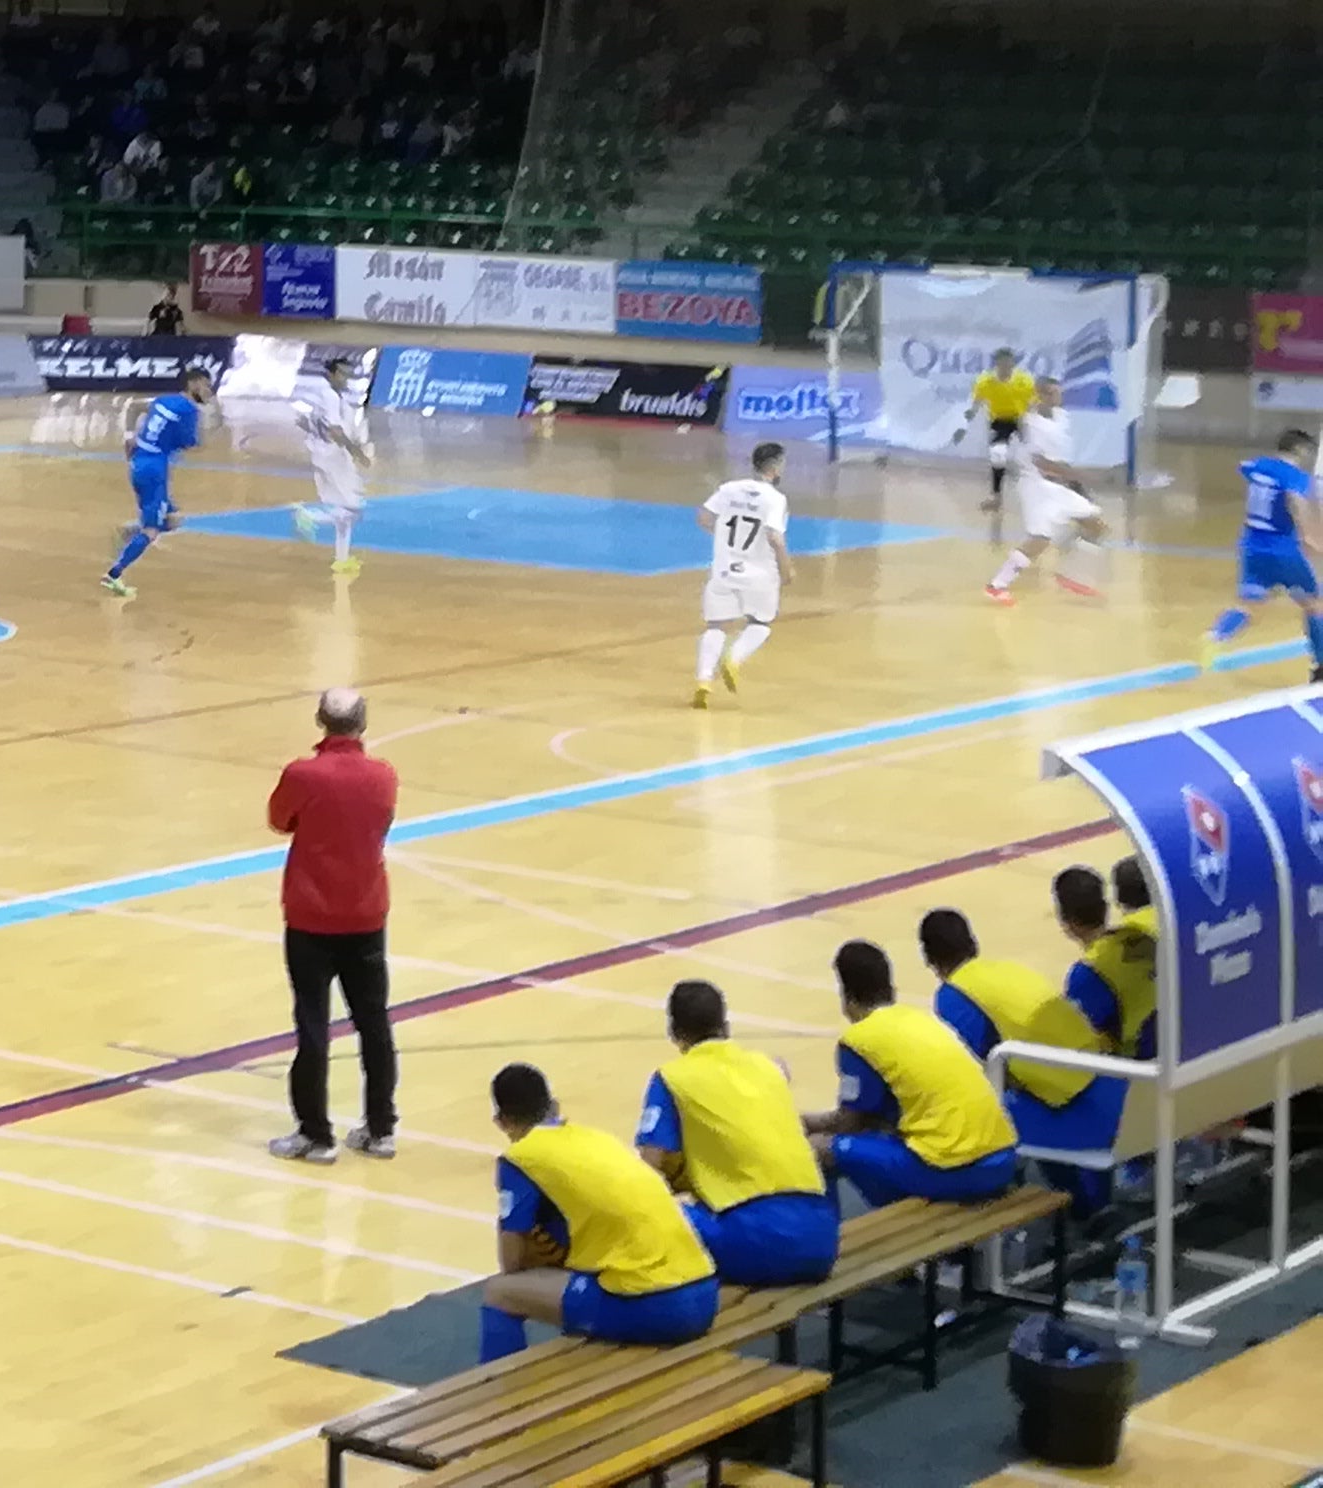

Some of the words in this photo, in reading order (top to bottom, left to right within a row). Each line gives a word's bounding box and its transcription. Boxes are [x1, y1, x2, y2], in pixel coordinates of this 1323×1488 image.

[618, 291, 759, 326] BEZOYA
[37, 355, 181, 379] KELME
[726, 514, 762, 551] 17
